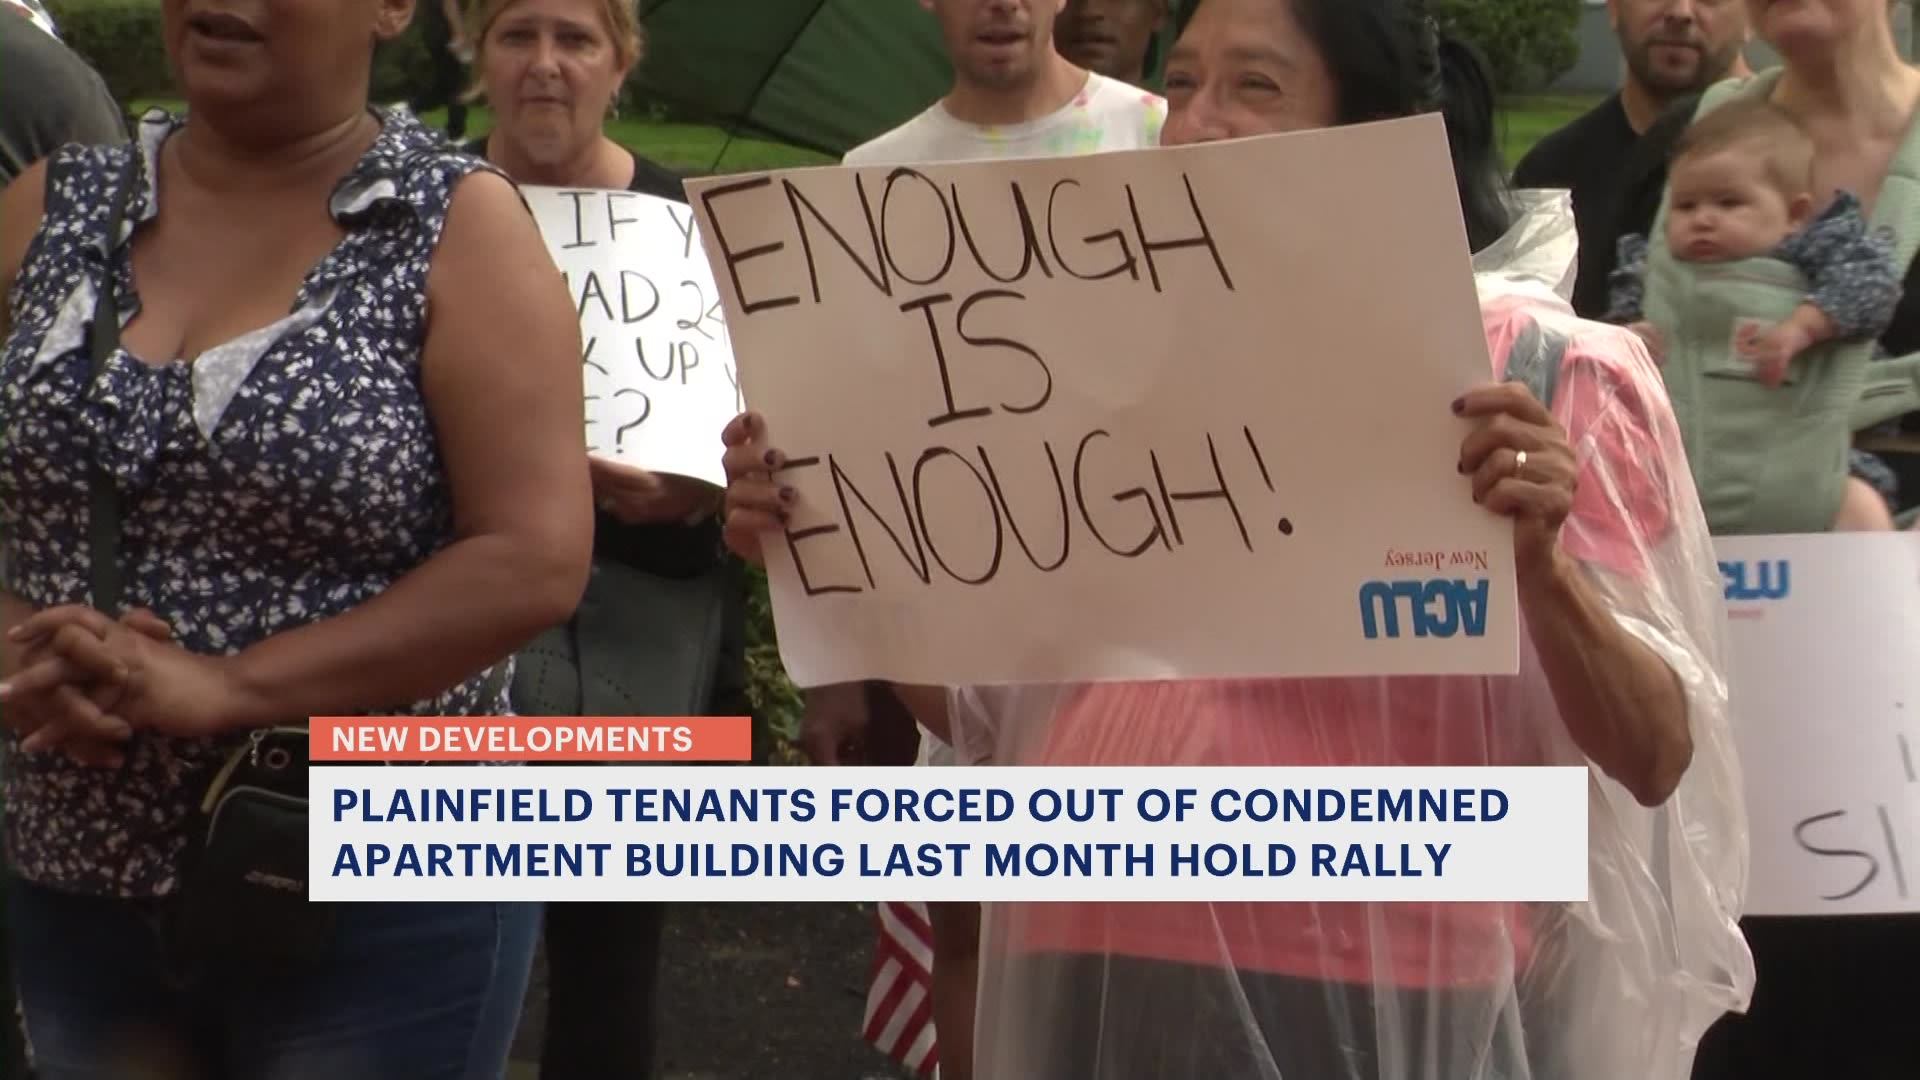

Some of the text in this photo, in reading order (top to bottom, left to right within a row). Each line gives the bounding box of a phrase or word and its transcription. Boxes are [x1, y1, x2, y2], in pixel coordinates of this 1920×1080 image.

[557, 191, 638, 249] IF
[701, 167, 1235, 315] ENOUGH
[562, 270, 660, 325] AD
[635, 336, 699, 385] UP
[899, 290, 1052, 427] IS
[769, 424, 1295, 597] ENOUGH!
[1384, 546, 1488, 571] New Jersey
[1359, 578, 1489, 639] ACLU
